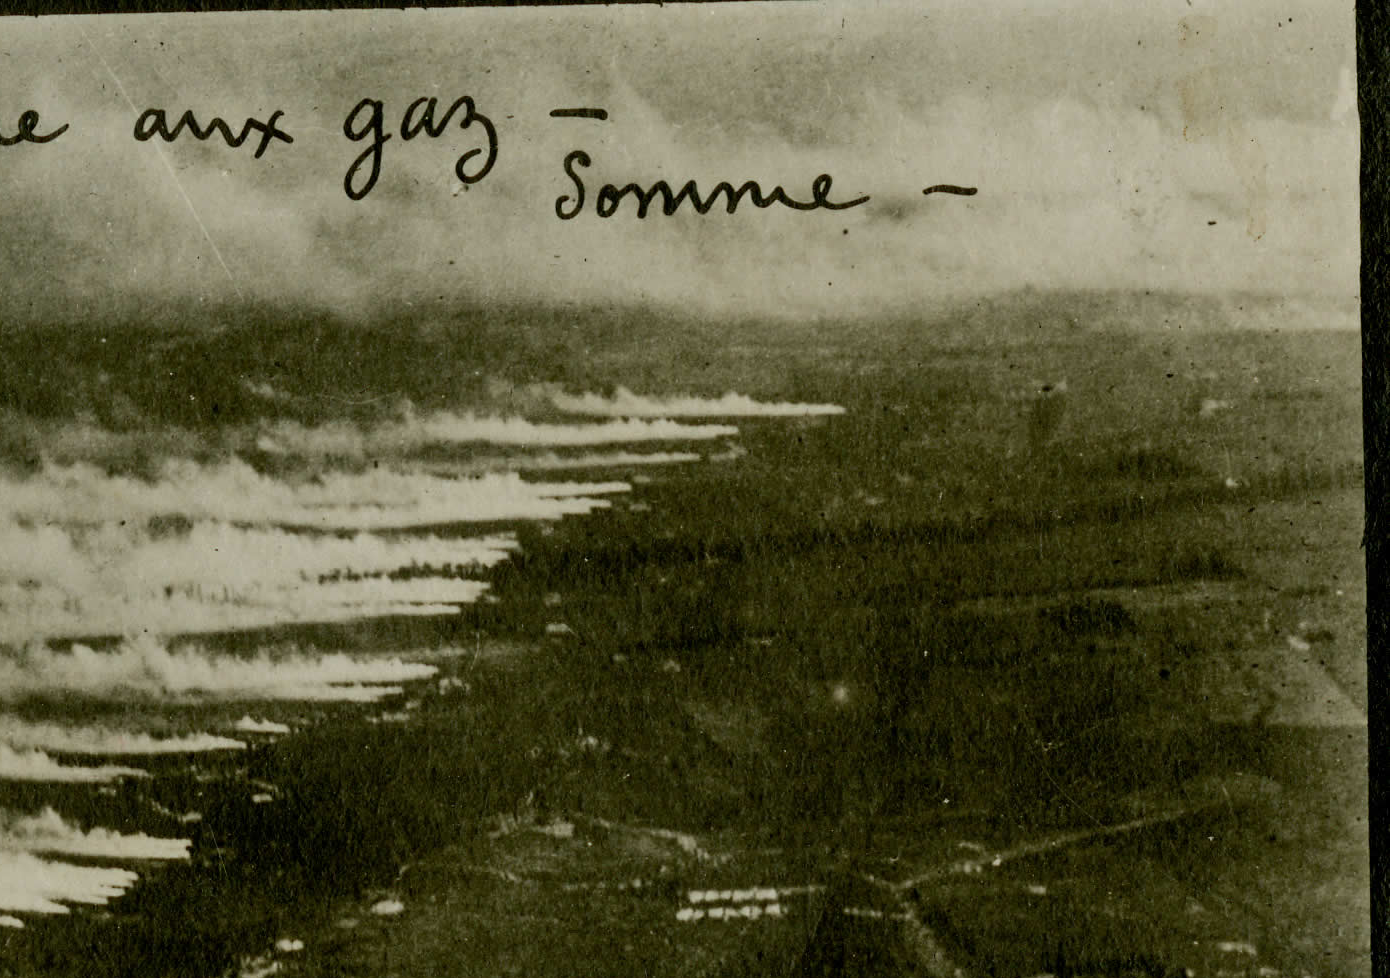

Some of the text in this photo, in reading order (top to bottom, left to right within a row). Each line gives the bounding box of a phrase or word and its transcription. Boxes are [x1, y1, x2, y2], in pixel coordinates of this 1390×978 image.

[133, 108, 294, 159] aux
[343, 95, 499, 201] gaz
[555, 150, 870, 220] Somme
